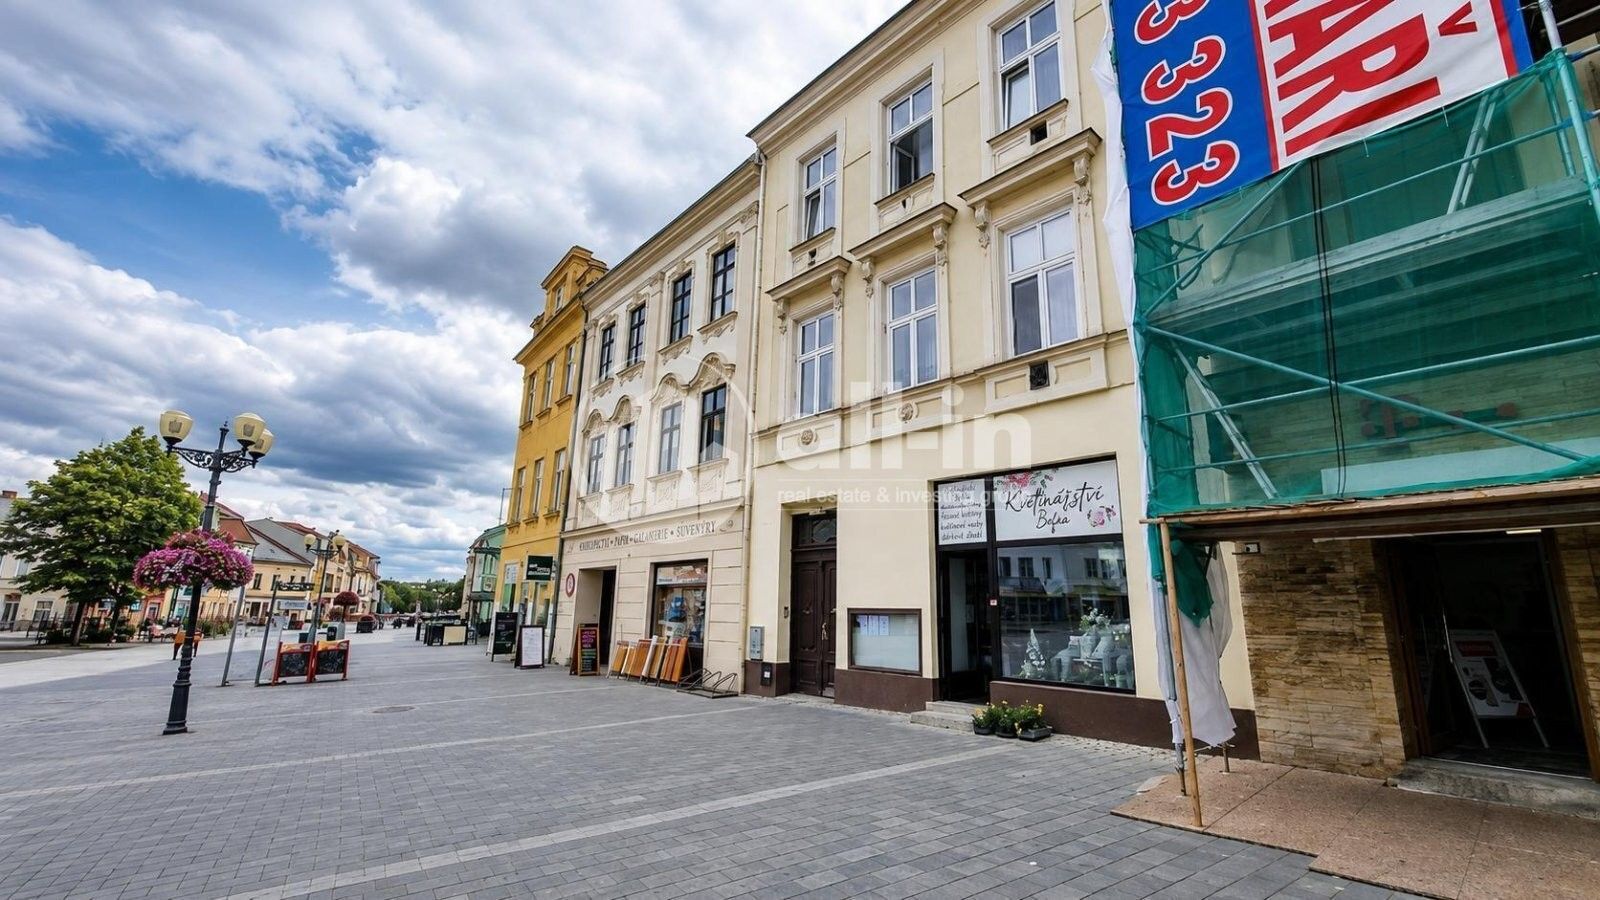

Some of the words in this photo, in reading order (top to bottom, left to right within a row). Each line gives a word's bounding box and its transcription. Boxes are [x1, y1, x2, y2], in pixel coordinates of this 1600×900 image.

[1141, 34, 1240, 206] 323
[1265, 0, 1478, 157] AŘI
[1005, 481, 1105, 516] Květinářství
